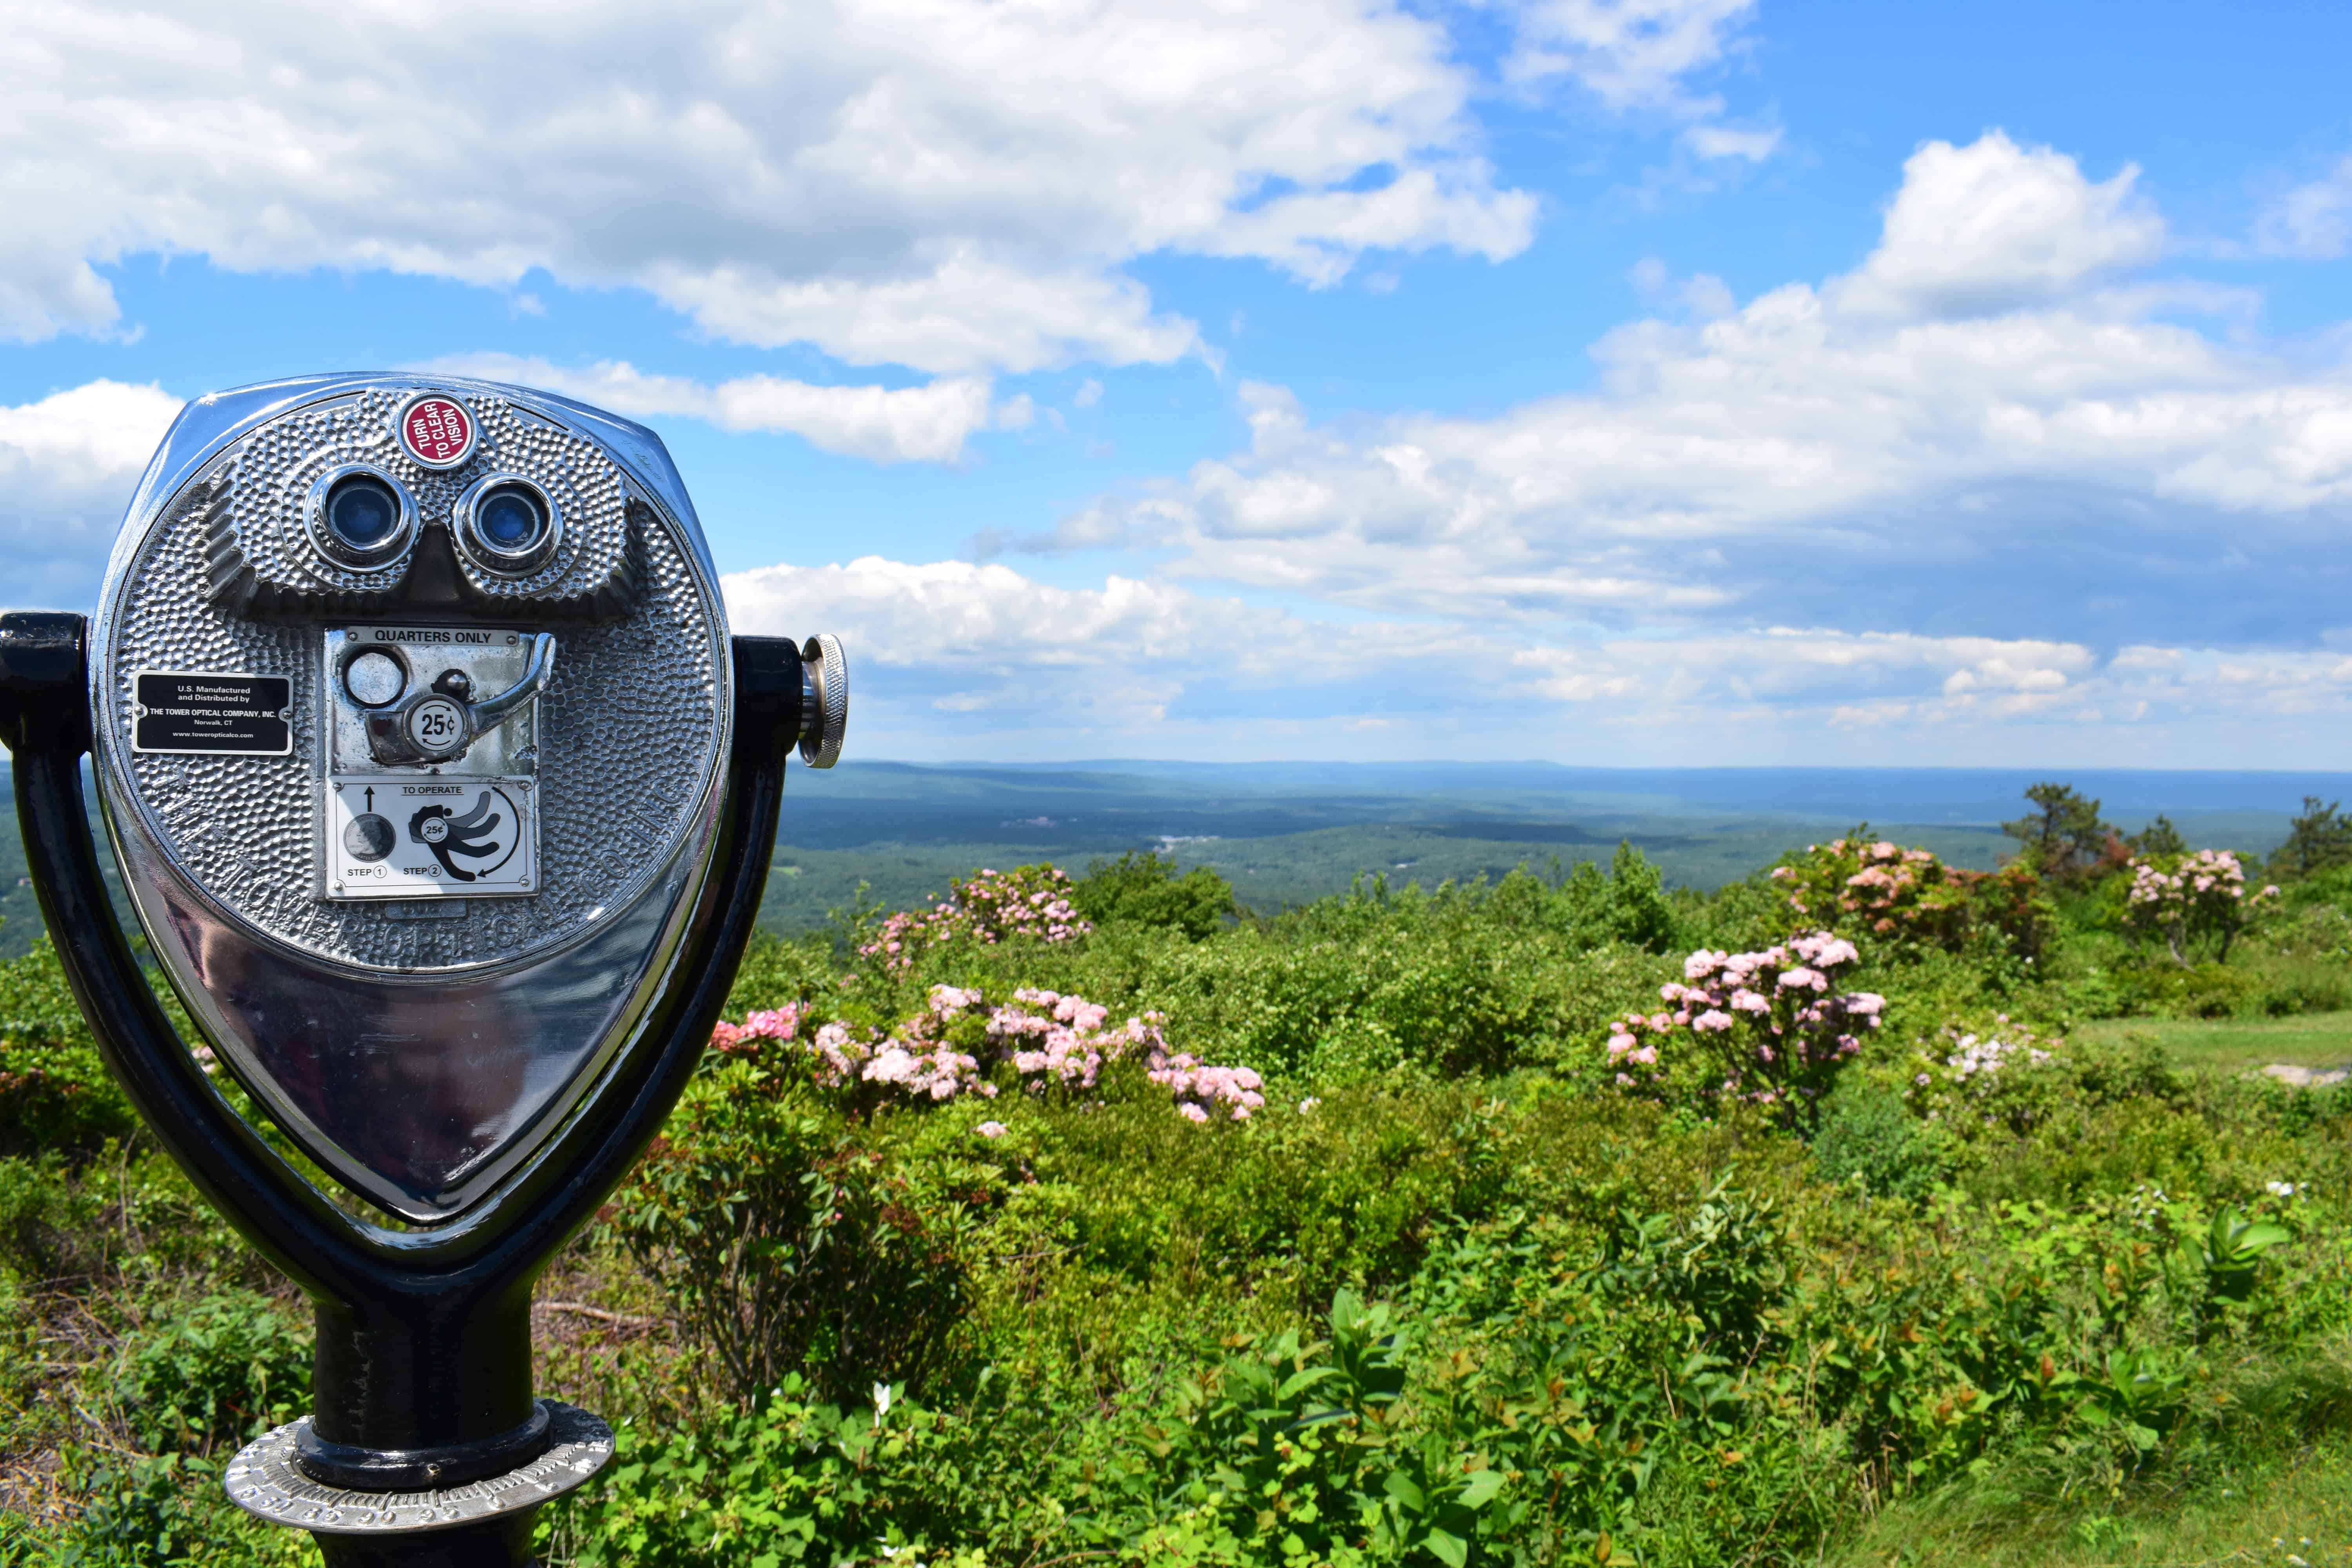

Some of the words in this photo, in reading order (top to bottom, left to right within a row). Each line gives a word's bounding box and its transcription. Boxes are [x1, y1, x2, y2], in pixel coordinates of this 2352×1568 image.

[424, 403, 445, 439] CLEAR
[442, 409, 463, 446] VISION
[412, 419, 431, 450] TURN
[436, 442, 450, 458] TO
[375, 630, 450, 642] QUARTERS
[455, 632, 491, 643] ONLY
[196, 686, 250, 694] Manufactured
[223, 710, 261, 718] COMPANY,
[422, 714, 454, 735] 25¢
[426, 825, 443, 834] 25¢
